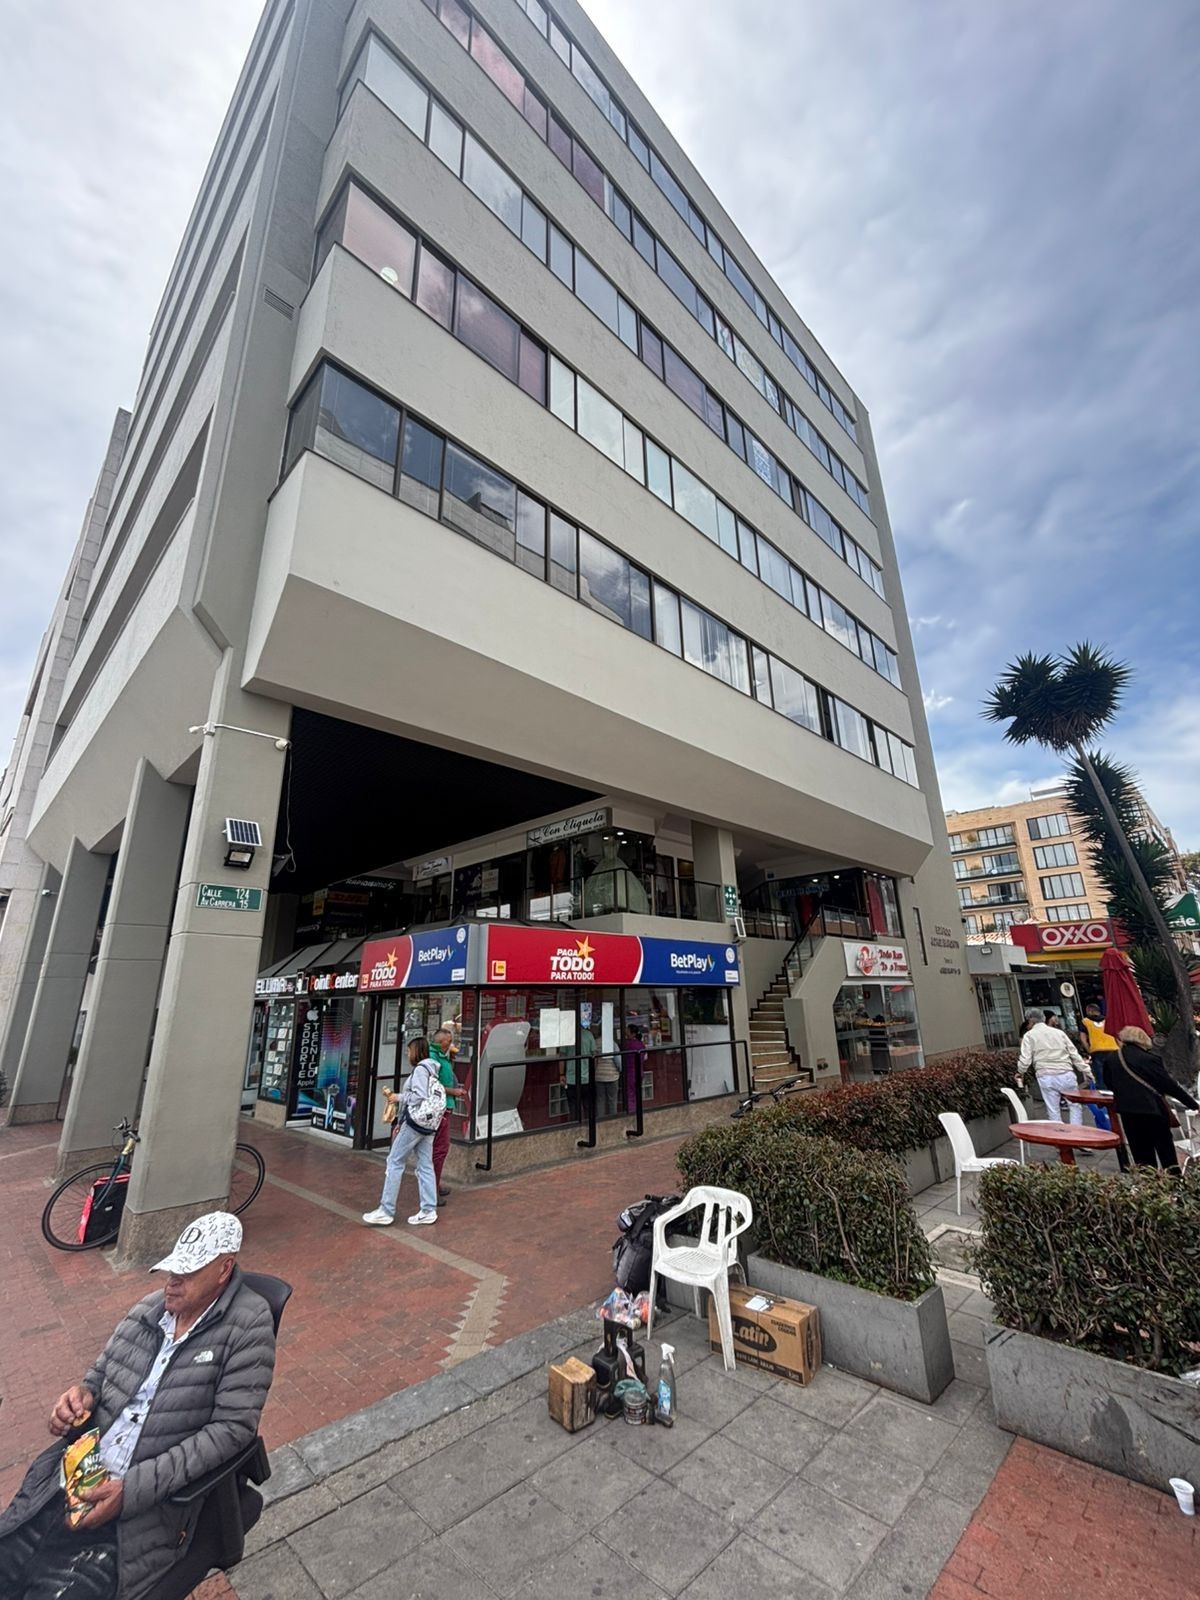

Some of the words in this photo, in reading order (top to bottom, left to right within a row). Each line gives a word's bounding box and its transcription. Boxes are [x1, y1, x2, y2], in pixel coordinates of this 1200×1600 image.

[201, 885, 223, 898] CALLE
[236, 889, 249, 900] 124
[240, 899, 249, 909] 15
[1042, 923, 1108, 947] OXXO
[418, 946, 448, 962] BetPlay
[557, 948, 578, 956] PAGA
[550, 956, 595, 972] TODO
[670, 953, 708, 972] BetPlay
[371, 966, 397, 980] TODO
[298, 1022, 311, 1079] SOPORTE
[297, 1079, 315, 1087] Apple
